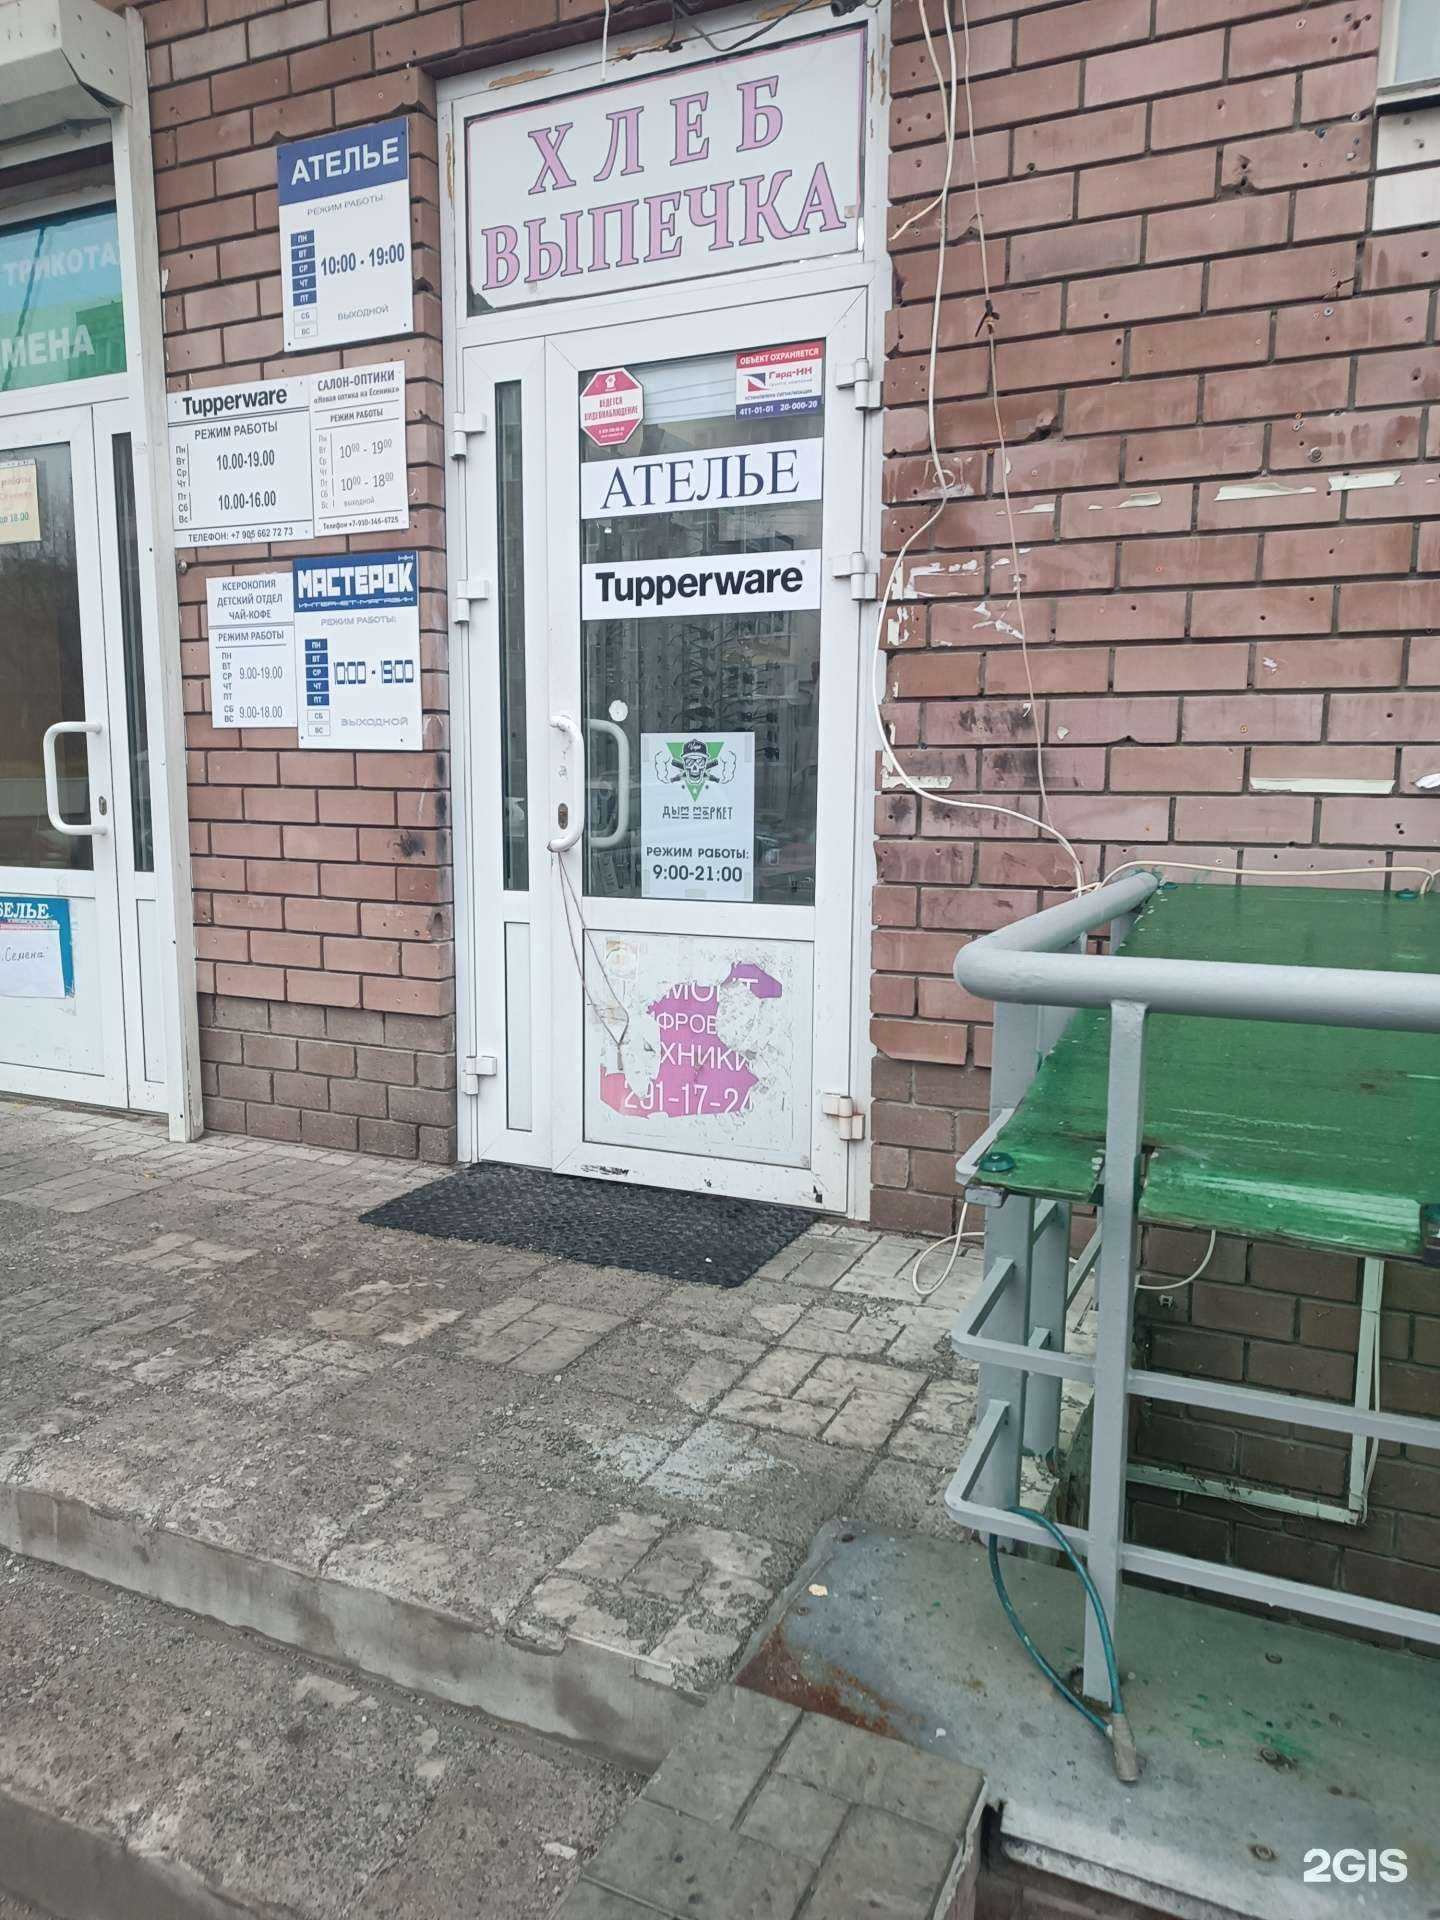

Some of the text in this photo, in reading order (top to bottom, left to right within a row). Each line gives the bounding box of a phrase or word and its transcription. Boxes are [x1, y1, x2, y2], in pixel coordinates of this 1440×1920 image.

[528, 74, 783, 195] ХЛЕБ
[291, 137, 399, 186] АТЕЛЬЕ
[307, 193, 383, 216] РЕЖИМ РАБОТЫ
[481, 161, 847, 290] ВЫПЕЧКА
[321, 252, 356, 276] 10:00
[369, 242, 405, 267] 19:00
[338, 304, 389, 321] ВЫХОДНОЙ
[740, 347, 819, 365] ОБЪЕКТ ОХРАНЯЕТСЯ
[317, 370, 395, 392] САЛОН-ОПТИКИ
[182, 388, 288, 417] Tupperware
[330, 408, 384, 423] РЕЖИМ РАБОТЫ
[194, 421, 278, 440] РЕЖИМ РАБОТЫ
[216, 449, 275, 471] 10.00-19.00
[600, 449, 800, 510] АТЕЛЬЕ
[218, 490, 276, 511] 10.00-16.00
[188, 533, 229, 543] ТЕЛЕФОН:
[222, 579, 276, 591] КСЕРОКОПИЯ
[298, 563, 414, 599] МАСТЕРОК
[595, 566, 803, 606] Tupperware
[217, 593, 283, 607] ДЕТСКИЙ ОТДЕЛ
[229, 609, 272, 620] ЧАЙ-КОФЕ
[321, 617, 355, 626] РЕЖИМ
[218, 630, 284, 642] РЕЖИМ РАБОТЫ
[221, 652, 232, 660] ПН
[222, 662, 231, 670] ВТ
[239, 666, 283, 680] 9.00-19.00
[223, 693, 232, 701] ПТ
[224, 705, 234, 713] СБ
[239, 706, 283, 718] 9.00-18.00
[224, 715, 234, 723] ВС
[341, 717, 408, 727] ВЫХОДНОЙ
[652, 864, 743, 882] 9:00-21:00
